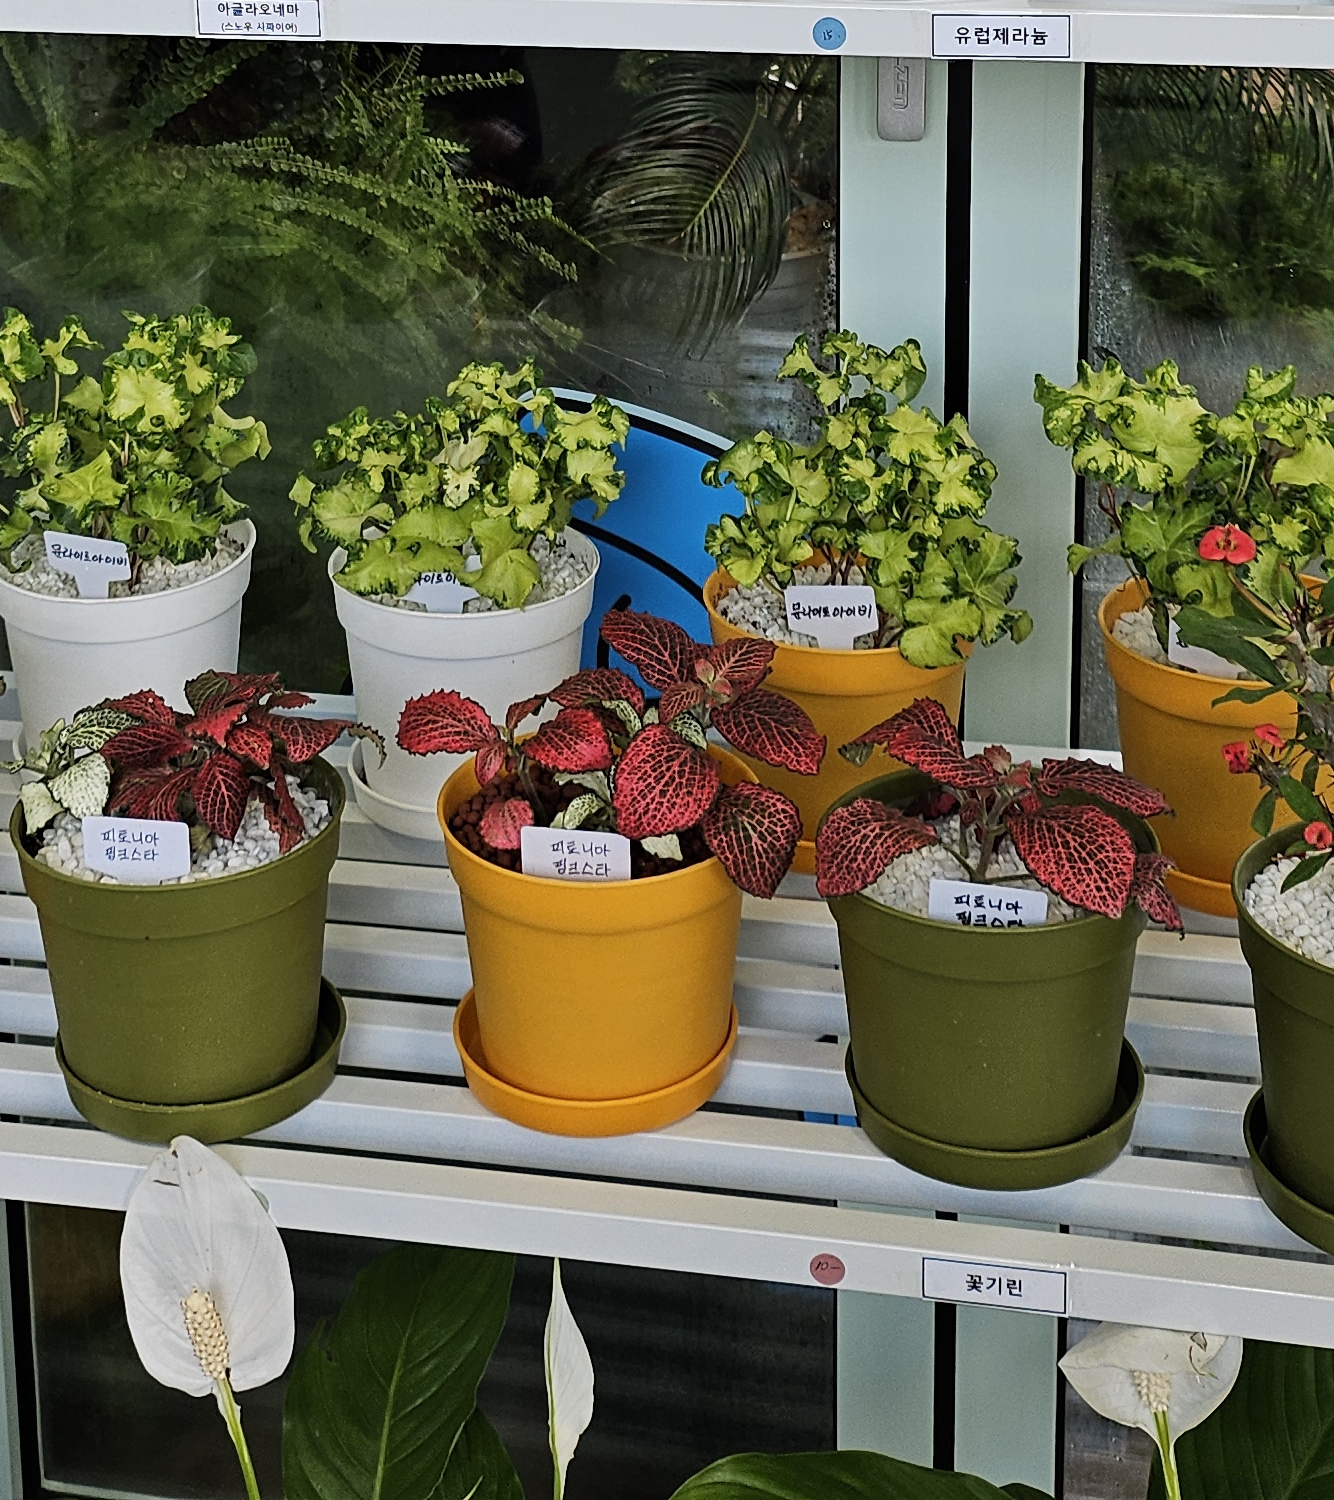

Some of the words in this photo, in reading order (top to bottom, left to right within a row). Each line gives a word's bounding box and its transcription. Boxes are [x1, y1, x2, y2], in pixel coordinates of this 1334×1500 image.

[218, 1, 299, 18] 아글라오네마
[221, 21, 253, 34] (스노우
[954, 25, 1050, 47] 유럽제라늄
[51, 543, 129, 568] 문라이트아이비
[790, 602, 874, 621] 문라이트아이비
[101, 830, 159, 846] 피토니아
[105, 847, 159, 863] 핑크스타
[550, 840, 611, 858] 피토니아
[552, 858, 612, 878] 핑크스타
[954, 894, 1023, 914] 피토니아
[965, 1272, 1024, 1298] 꽃기린
